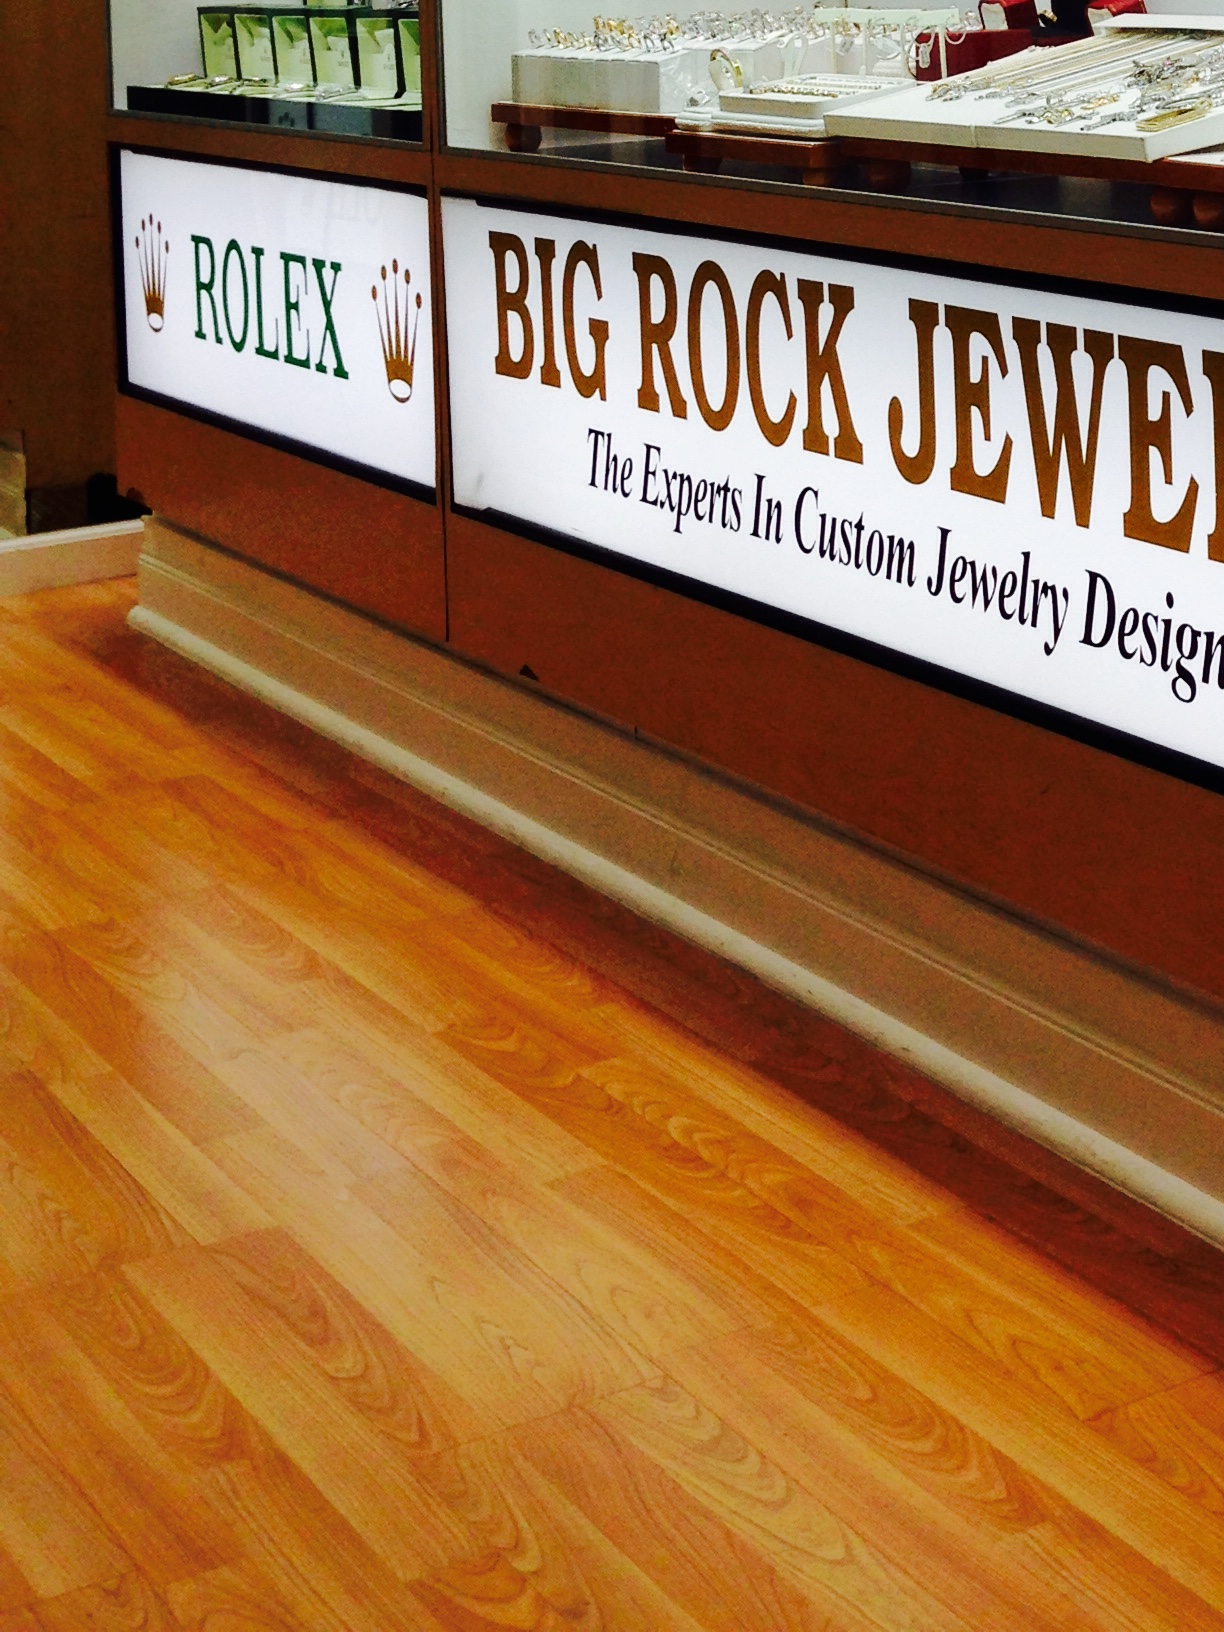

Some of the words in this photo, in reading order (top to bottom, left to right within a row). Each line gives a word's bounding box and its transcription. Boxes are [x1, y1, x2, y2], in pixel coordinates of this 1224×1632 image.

[190, 234, 350, 381] ROLEX
[488, 230, 610, 402] BIG
[632, 252, 864, 465] ROCK
[587, 428, 634, 499] The
[639, 443, 743, 534] Experts
[750, 473, 784, 545] In
[794, 486, 917, 587] Custom
[926, 526, 1069, 656] Jewelry
